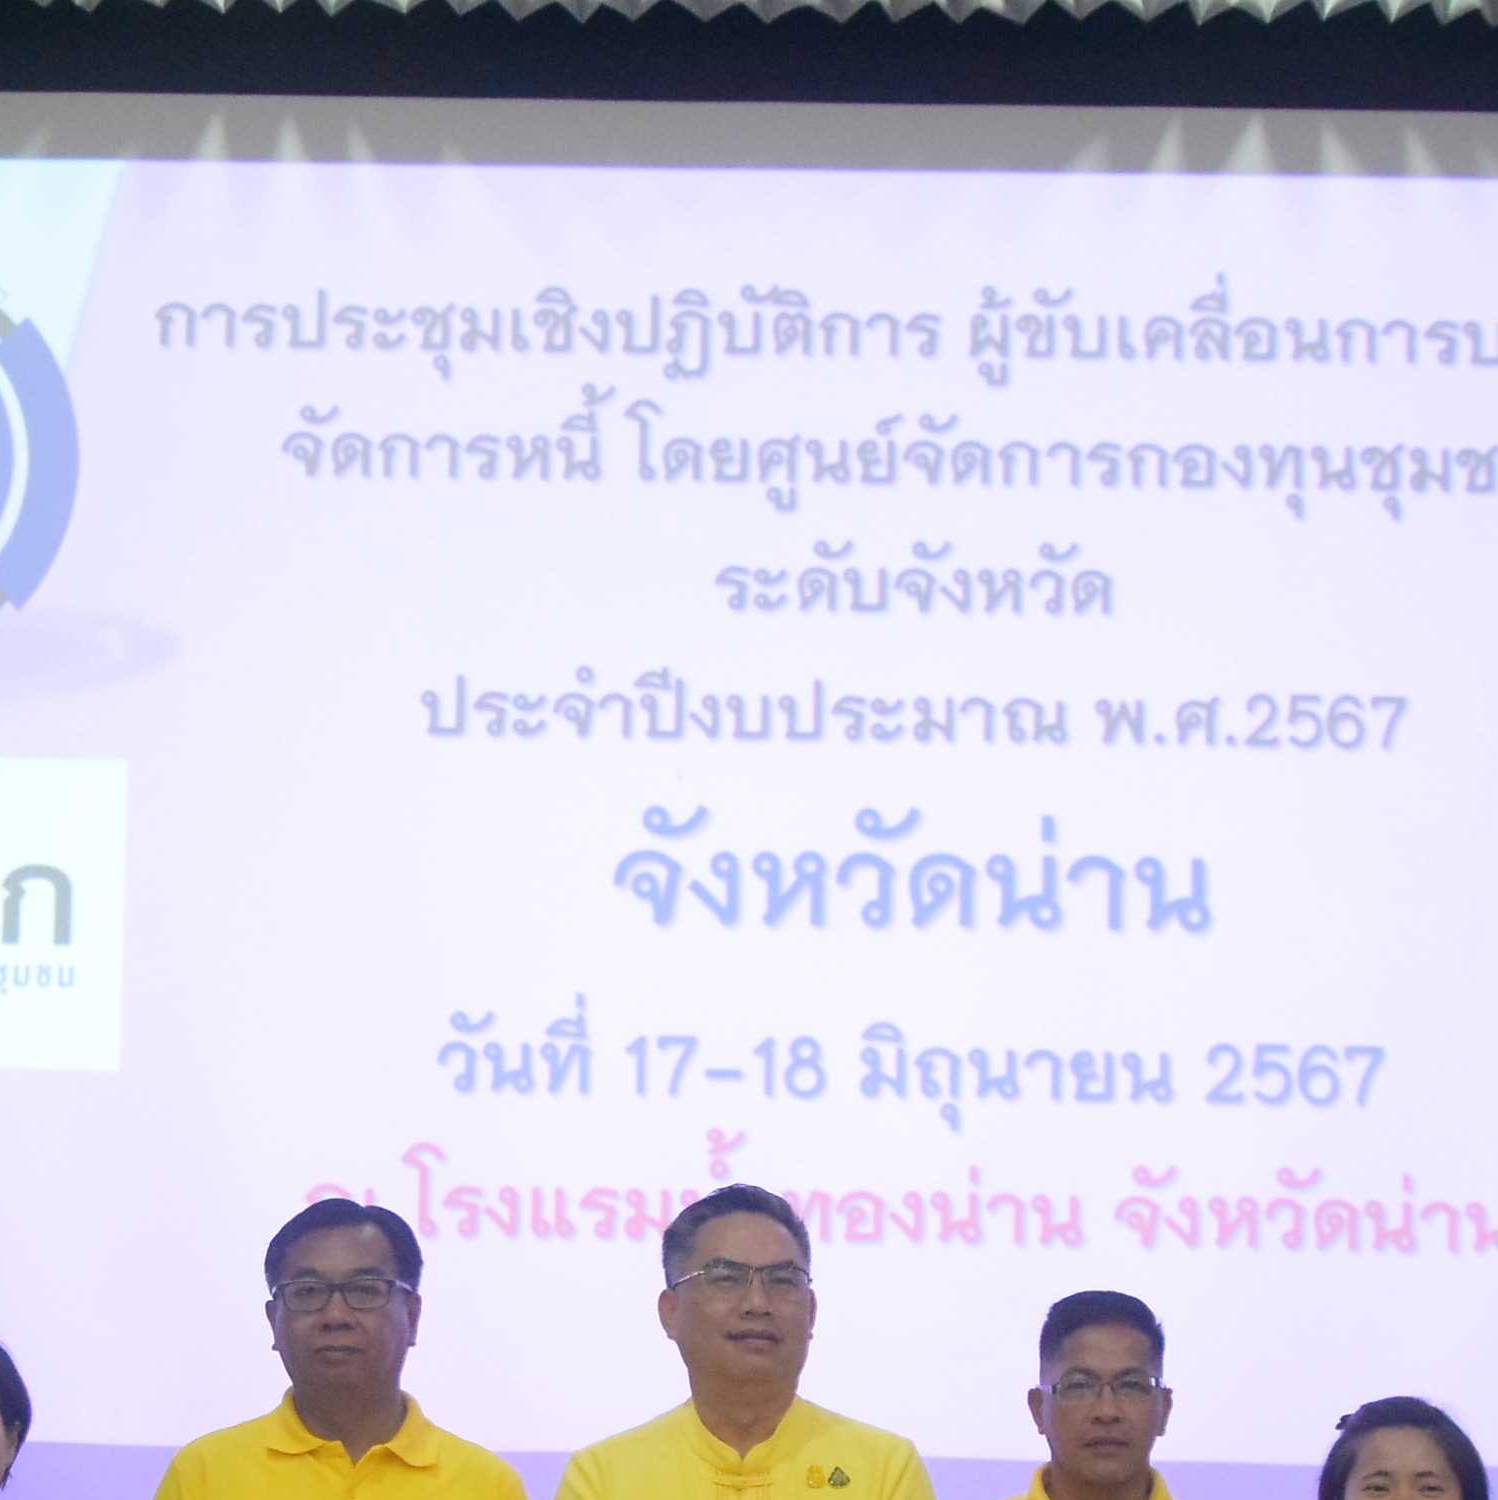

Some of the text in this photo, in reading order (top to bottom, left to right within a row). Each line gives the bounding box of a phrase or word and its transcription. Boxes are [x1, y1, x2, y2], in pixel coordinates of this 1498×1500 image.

[155, 284, 942, 383] การประชุมเชิงปฏิบัติการ
[281, 383, 616, 482] จัดการหนี้
[714, 540, 1115, 617] ระดับจังหวัด
[420, 665, 1410, 752] ประจำปีงบประมาณ พ.ศ.2567
[612, 804, 1215, 937] จังหวัดน่าน
[436, 992, 1387, 1134] วันที่ 17-18 มิถุนายน 2567
